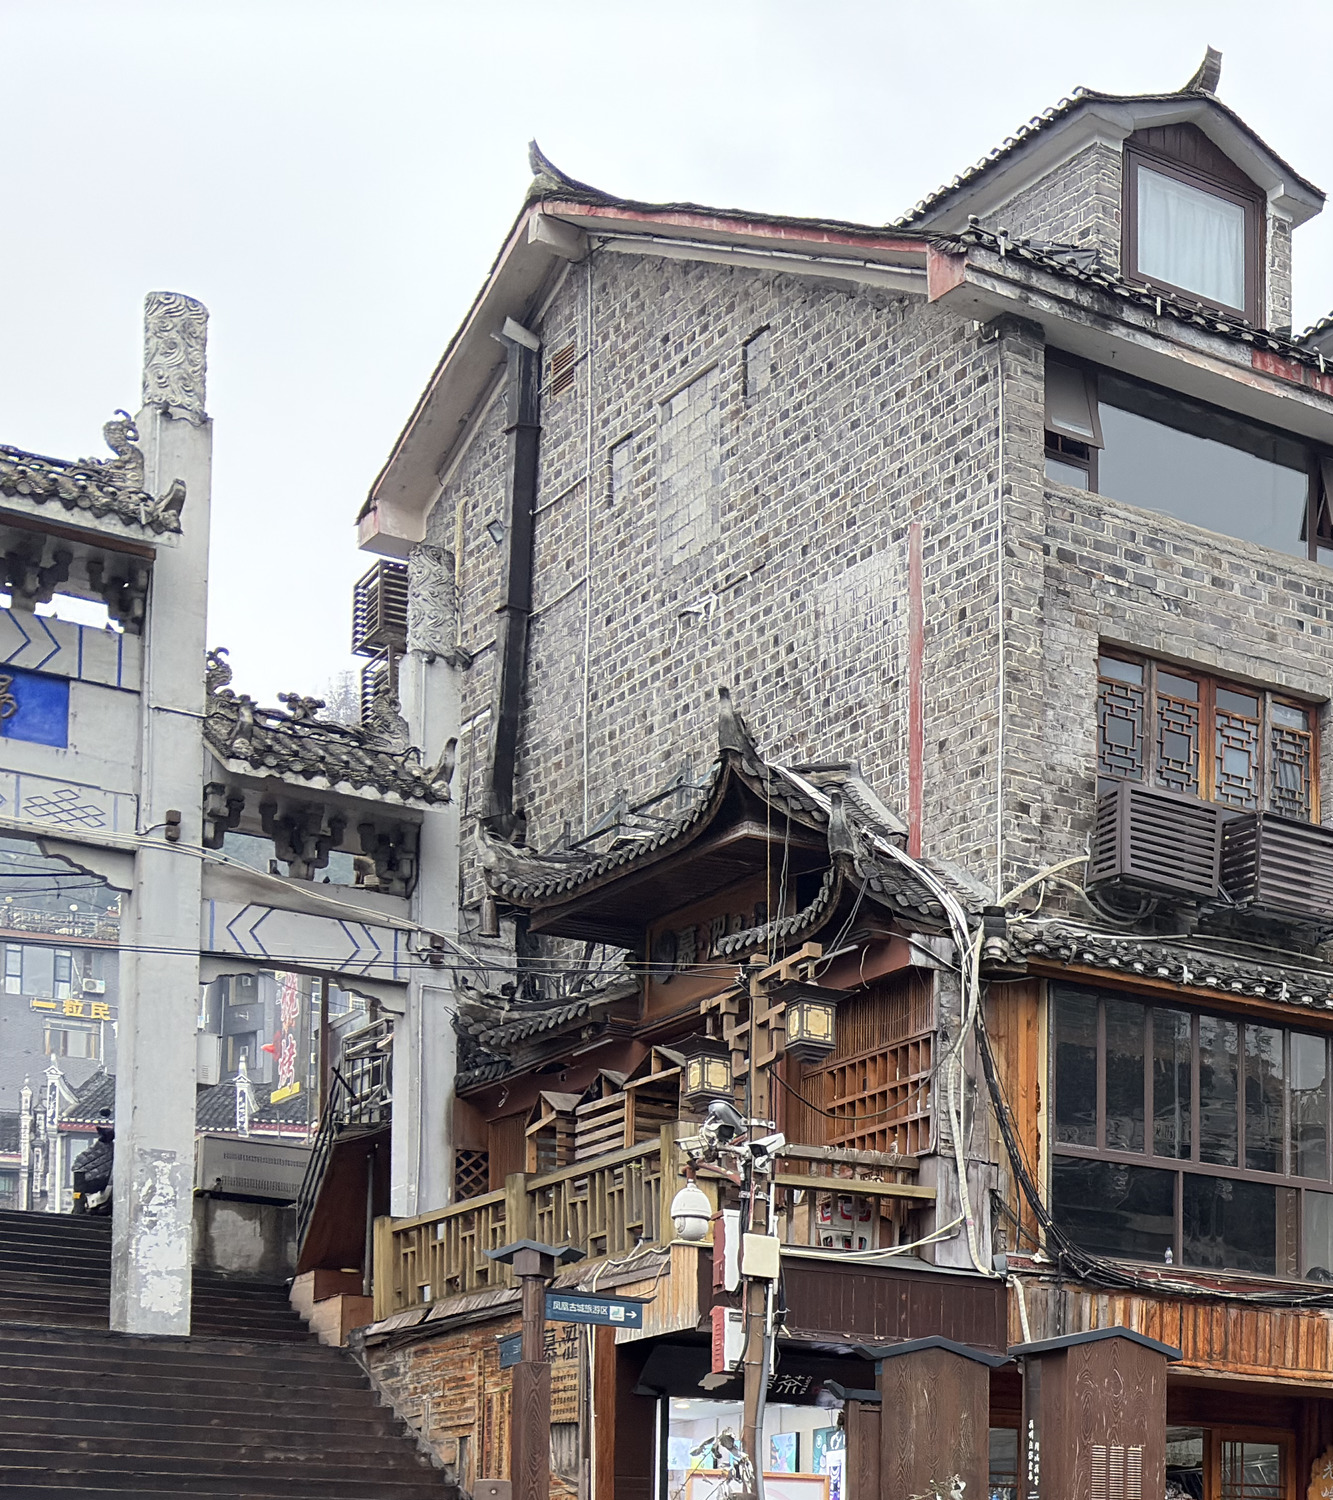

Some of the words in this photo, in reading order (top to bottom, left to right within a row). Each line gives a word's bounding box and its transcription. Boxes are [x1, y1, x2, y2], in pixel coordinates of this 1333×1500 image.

[553, 1301, 608, 1316] 凤凰古城旅游区
